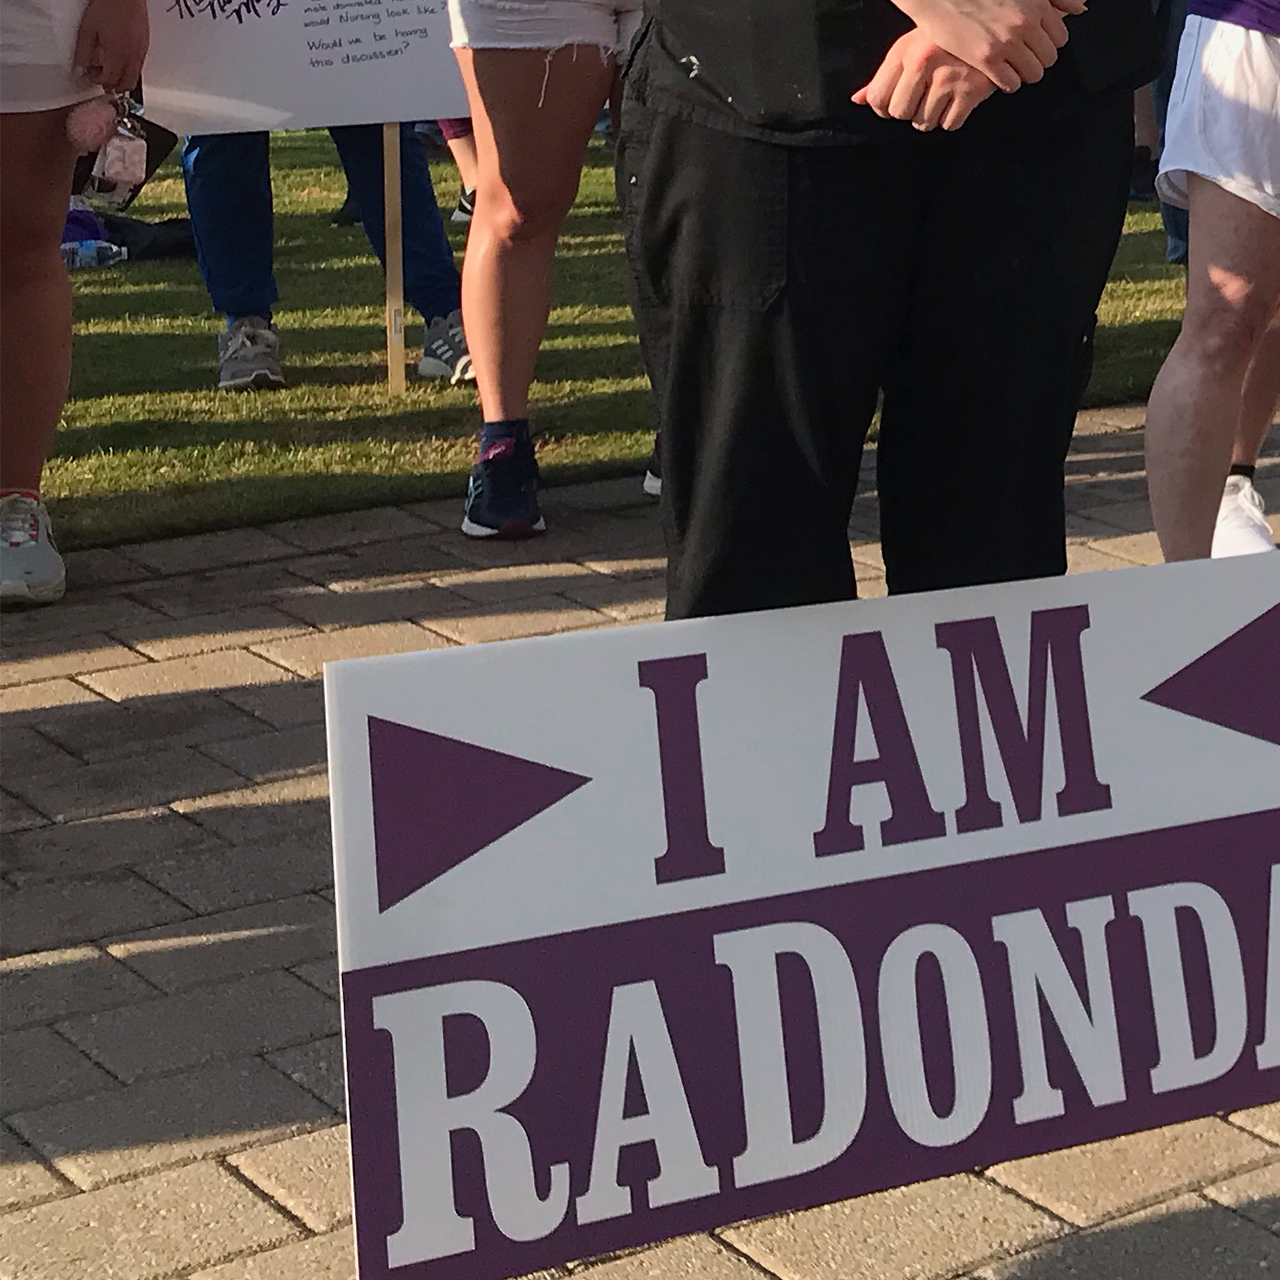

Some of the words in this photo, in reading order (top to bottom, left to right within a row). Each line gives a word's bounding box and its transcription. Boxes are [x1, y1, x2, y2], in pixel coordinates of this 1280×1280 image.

[339, 11, 382, 26] Nursing
[386, 7, 411, 19] look
[307, 38, 343, 51] Would
[348, 37, 363, 46] we
[373, 31, 387, 42] be
[395, 27, 429, 39] having
[309, 57, 334, 68] this
[341, 41, 411, 65] discussion?
[638, 653, 727, 887] I
[813, 603, 1114, 859] AM
